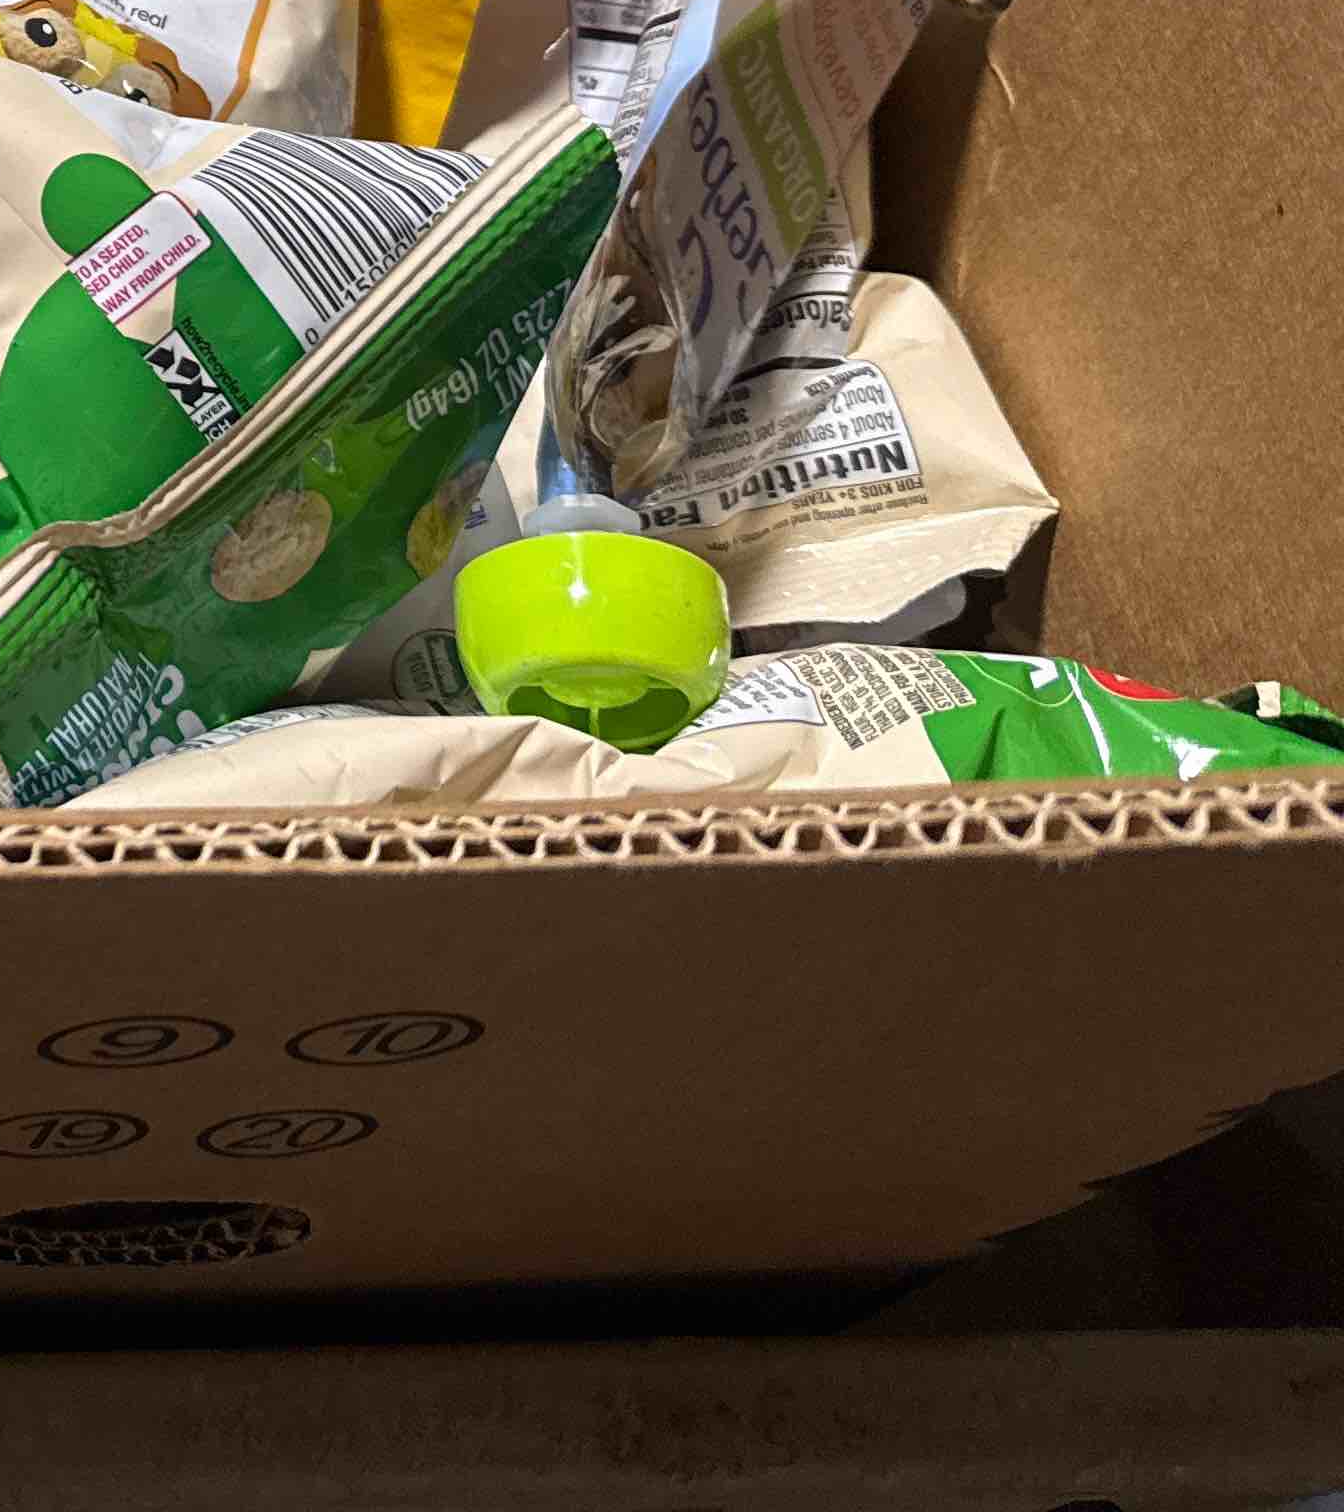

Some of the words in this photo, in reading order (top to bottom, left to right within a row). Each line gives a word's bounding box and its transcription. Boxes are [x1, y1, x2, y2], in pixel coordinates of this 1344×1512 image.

[108, 246, 150, 283] CHILD.
[132, 269, 165, 298] FROM
[162, 234, 203, 271] CHILD.
[407, 358, 479, 431] (64g)
[718, 440, 908, 510] Nutrition
[22, 1113, 126, 1150] 19
[240, 1113, 339, 1150] 20
